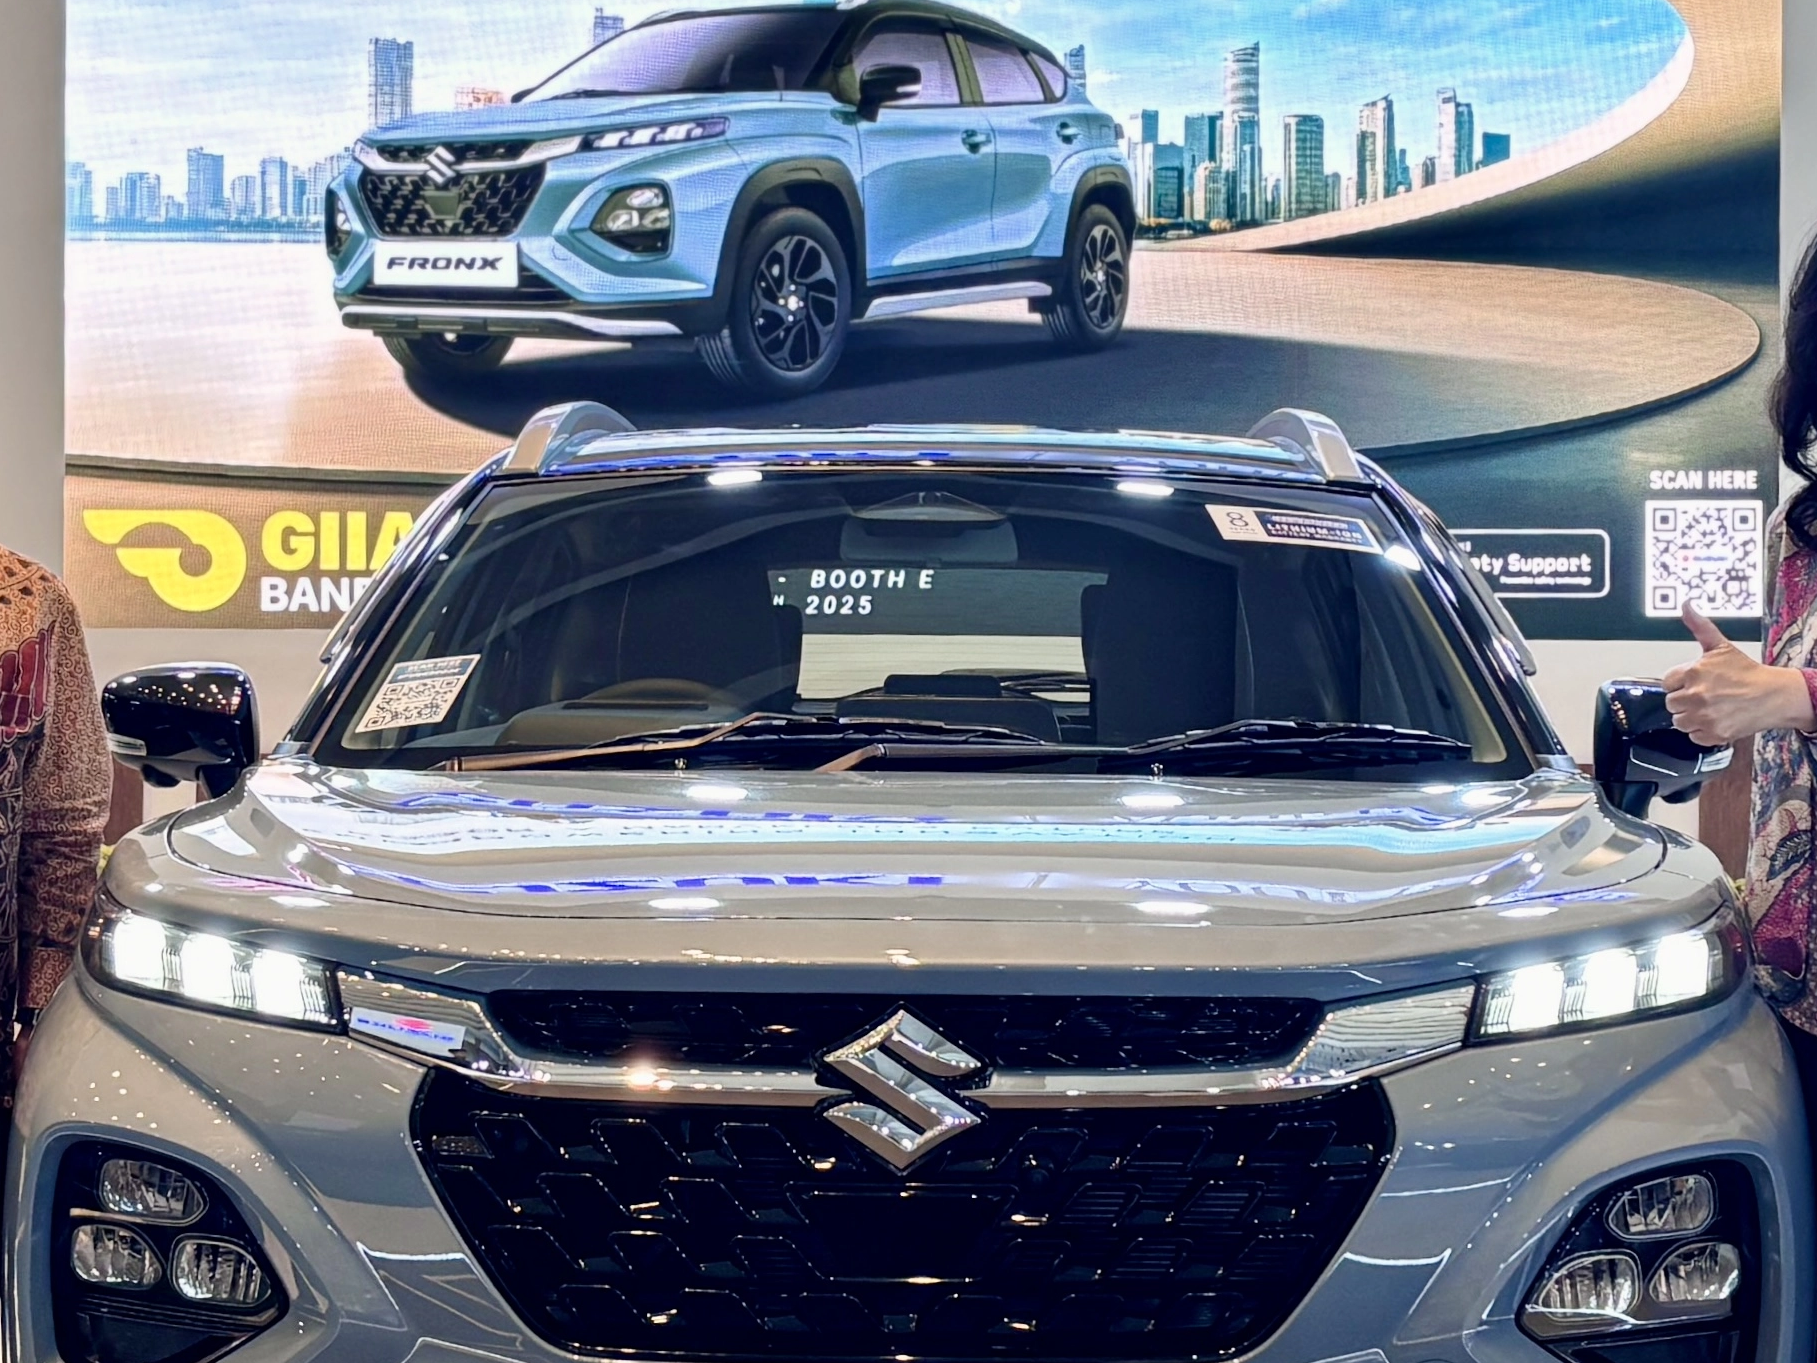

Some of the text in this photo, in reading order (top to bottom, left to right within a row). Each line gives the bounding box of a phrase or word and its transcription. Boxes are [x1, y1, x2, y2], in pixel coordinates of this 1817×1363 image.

[384, 255, 503, 272] FRONX
[1649, 470, 1758, 490] SCAN HERE
[1508, 553, 1592, 575] Support
[810, 569, 906, 589] BOOTH
[919, 569, 935, 589] E
[805, 595, 873, 615] 2025
